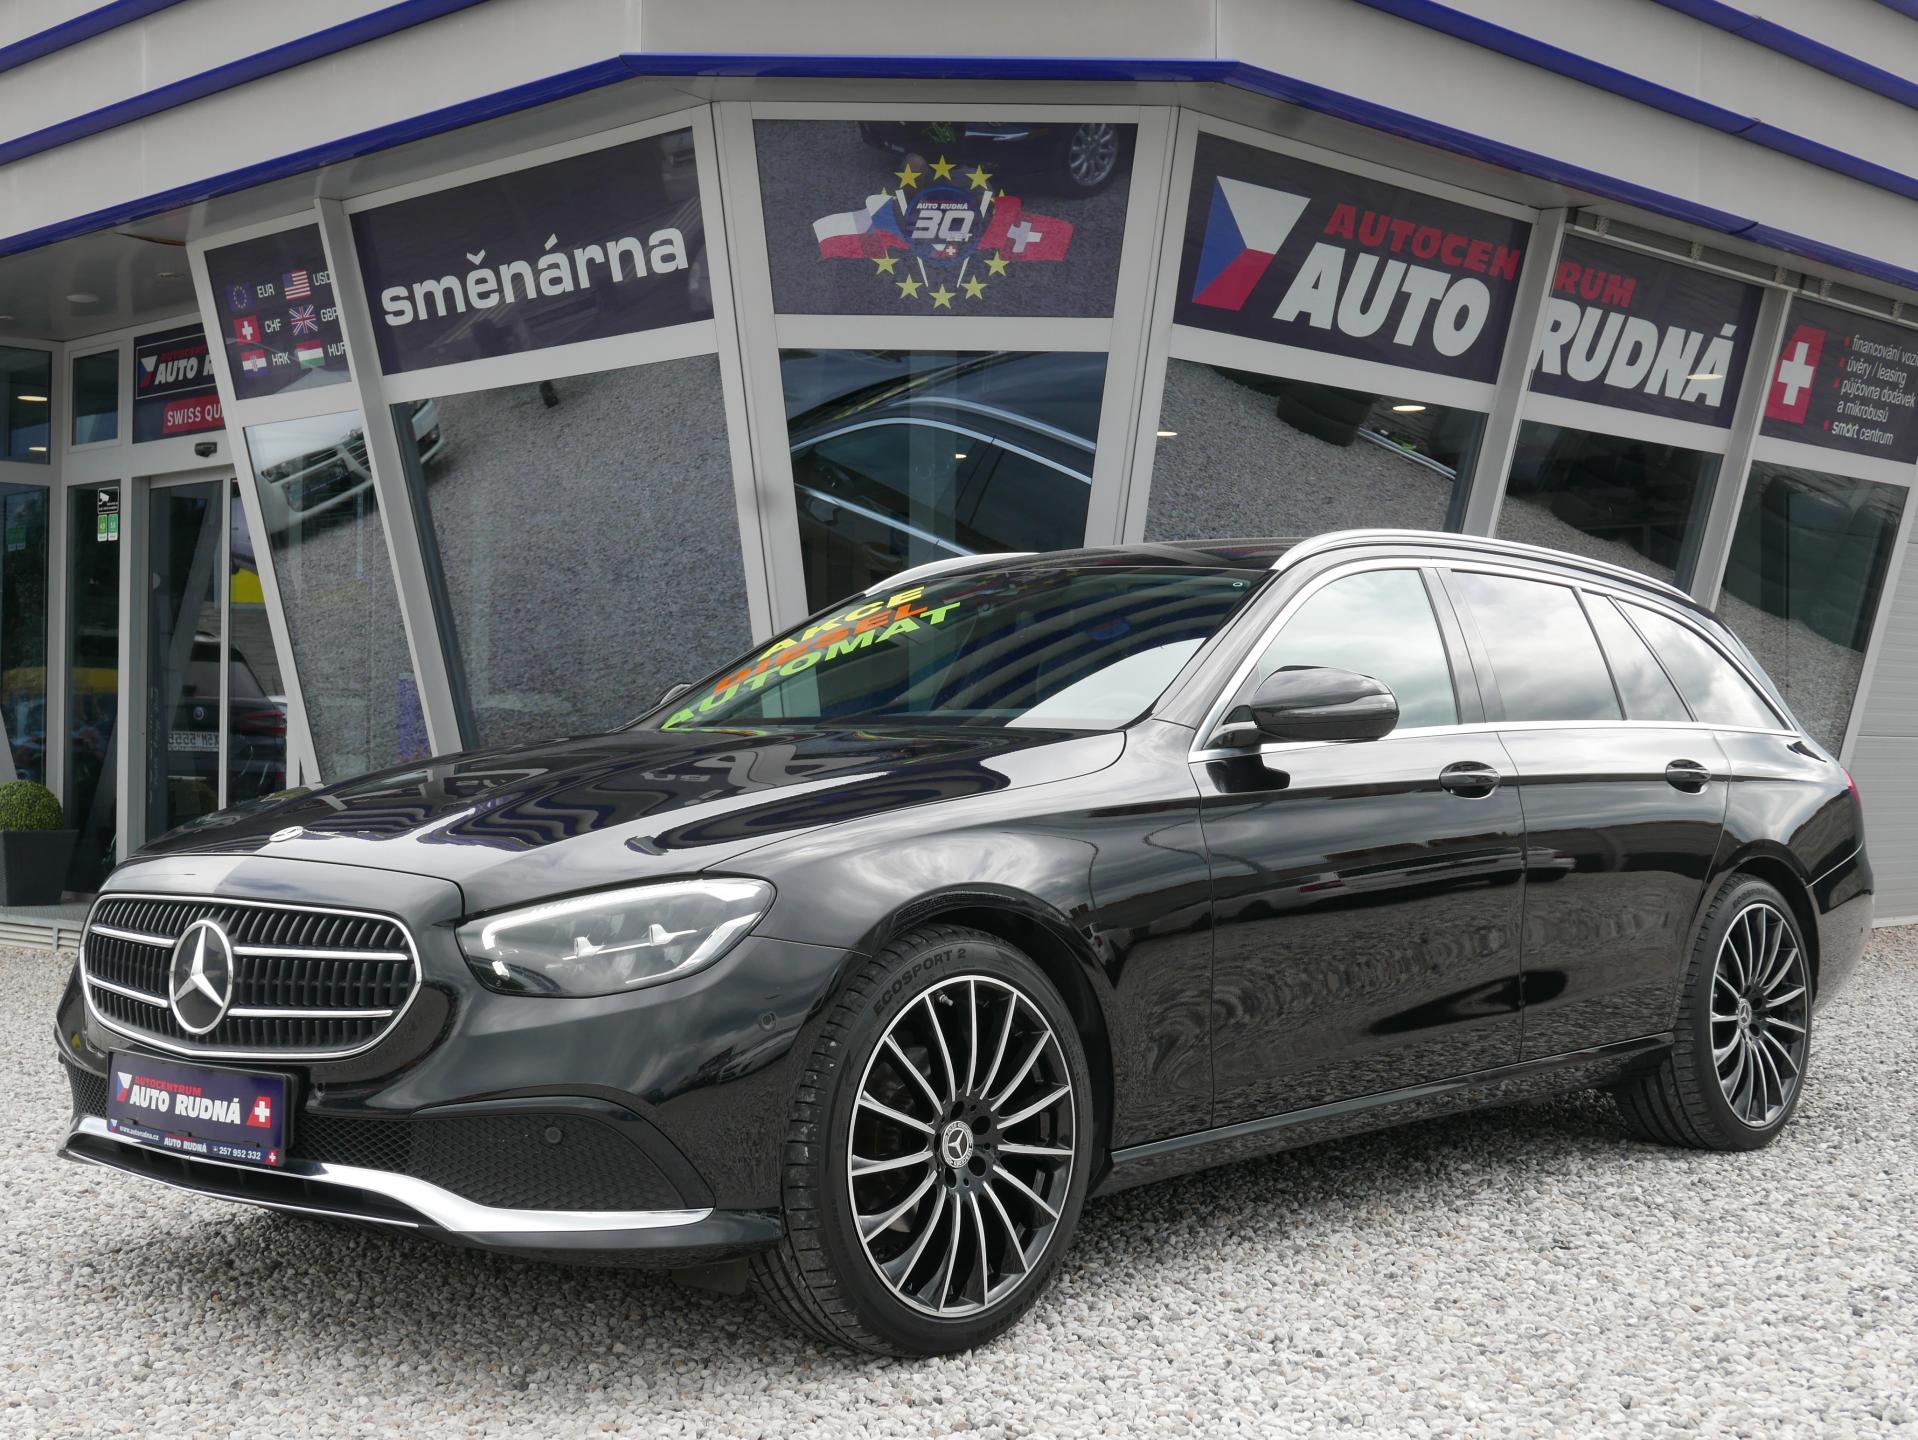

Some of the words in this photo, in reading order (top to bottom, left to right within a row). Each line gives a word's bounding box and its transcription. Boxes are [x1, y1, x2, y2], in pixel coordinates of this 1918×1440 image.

[916, 202, 938, 210] AUTO
[940, 202, 968, 210] RUDNÁ
[911, 210, 975, 239] 30
[313, 270, 331, 286] USD
[381, 227, 689, 326] směnárna
[257, 283, 275, 298] EUR
[264, 318, 281, 333] CHF
[1273, 241, 1491, 357] AUTO
[1531, 297, 1738, 407] RUDNÁ
[1852, 334, 1902, 360] financování
[271, 351, 290, 366] HRK
[154, 357, 198, 385] AUTO
[1847, 355, 1872, 379] úvěry
[1877, 363, 1907, 388] leasing
[1840, 377, 1881, 399] půjčovna
[1881, 386, 1917, 407] dodávek
[167, 405, 202, 426] SWISS
[1837, 400, 1845, 413] a
[1859, 427, 1894, 445] centrum
[756, 586, 925, 662] AKCE
[659, 602, 961, 730] AUTOMAT
[957, 948, 967, 959] 2
[134, 1075, 203, 1096] AUTOCENTRUM
[129, 1084, 170, 1113] AUTO
[175, 1094, 241, 1125] RUDNÁ
[164, 1137, 181, 1149] AUTO
[182, 1142, 207, 1153] RUDNÁ
[218, 1146, 232, 1156] 257
[232, 1148, 246, 1158] 952
[246, 1150, 261, 1160] 332
